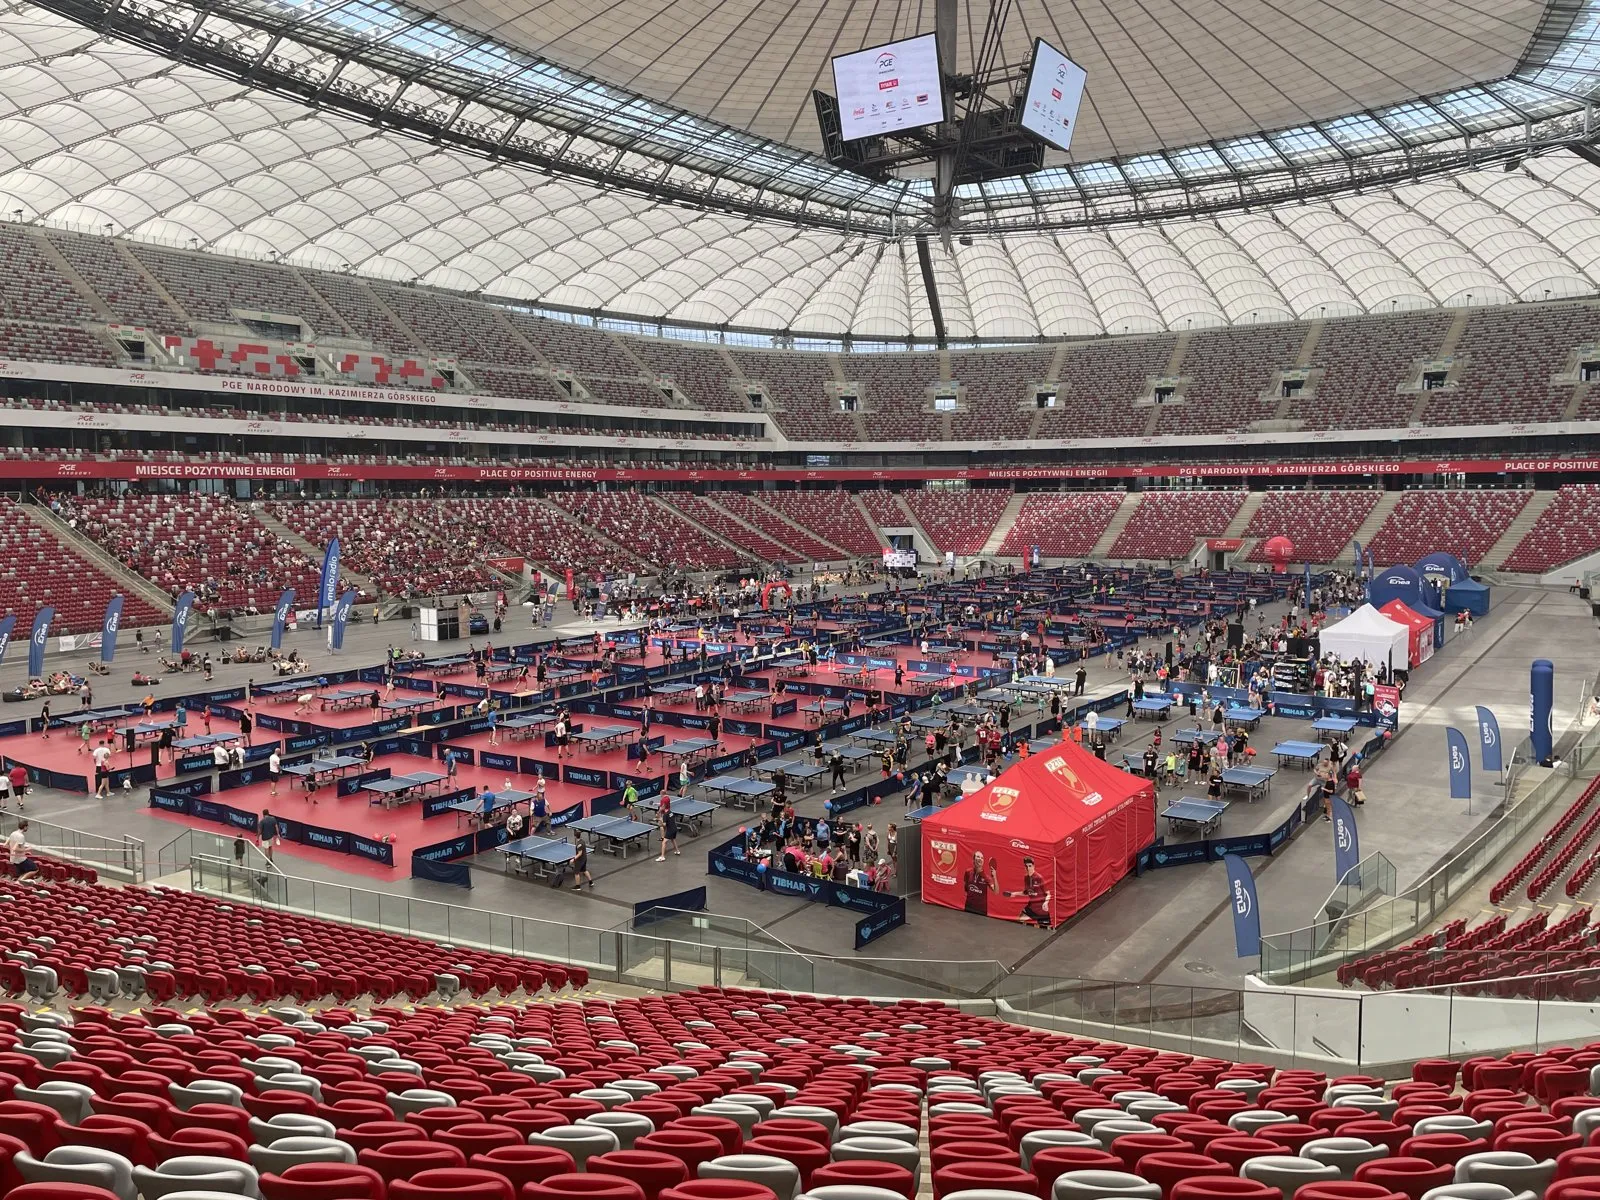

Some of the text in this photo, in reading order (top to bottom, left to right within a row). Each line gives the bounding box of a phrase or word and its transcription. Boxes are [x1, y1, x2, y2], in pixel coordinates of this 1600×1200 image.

[222, 380, 436, 403] PGE NARODOWY IM. KAZIMIERZA GÓRSKIEGO
[1277, 465, 1337, 473] KAZIMIERZA
[1340, 463, 1399, 472] GÓRSKIEGO
[1505, 461, 1599, 470] PLACE OF POSITIVE
[135, 465, 296, 477] MIEJSCE POZYTYWNEJ ENERGII
[480, 470, 597, 478] PLACE OF POSITIVE ENERGY
[328, 556, 338, 601] meloradio
[614, 708, 631, 716] TIBHAR
[1280, 708, 1305, 716] TIBHAR
[683, 718, 702, 726] TIBHAR
[292, 738, 316, 748] TIBHAR
[183, 759, 211, 769] TIBHAR
[486, 758, 504, 766] TIBHAR
[713, 760, 732, 770] TIBHAR
[569, 771, 591, 781] TIBHAR
[155, 795, 175, 806] TIBHAR
[229, 812, 246, 825] TIBHAR
[309, 832, 332, 844] TIBHAR
[355, 841, 378, 855] TIBHAR
[1012, 841, 1030, 850] Enea
[772, 876, 805, 891] TIBHAR
